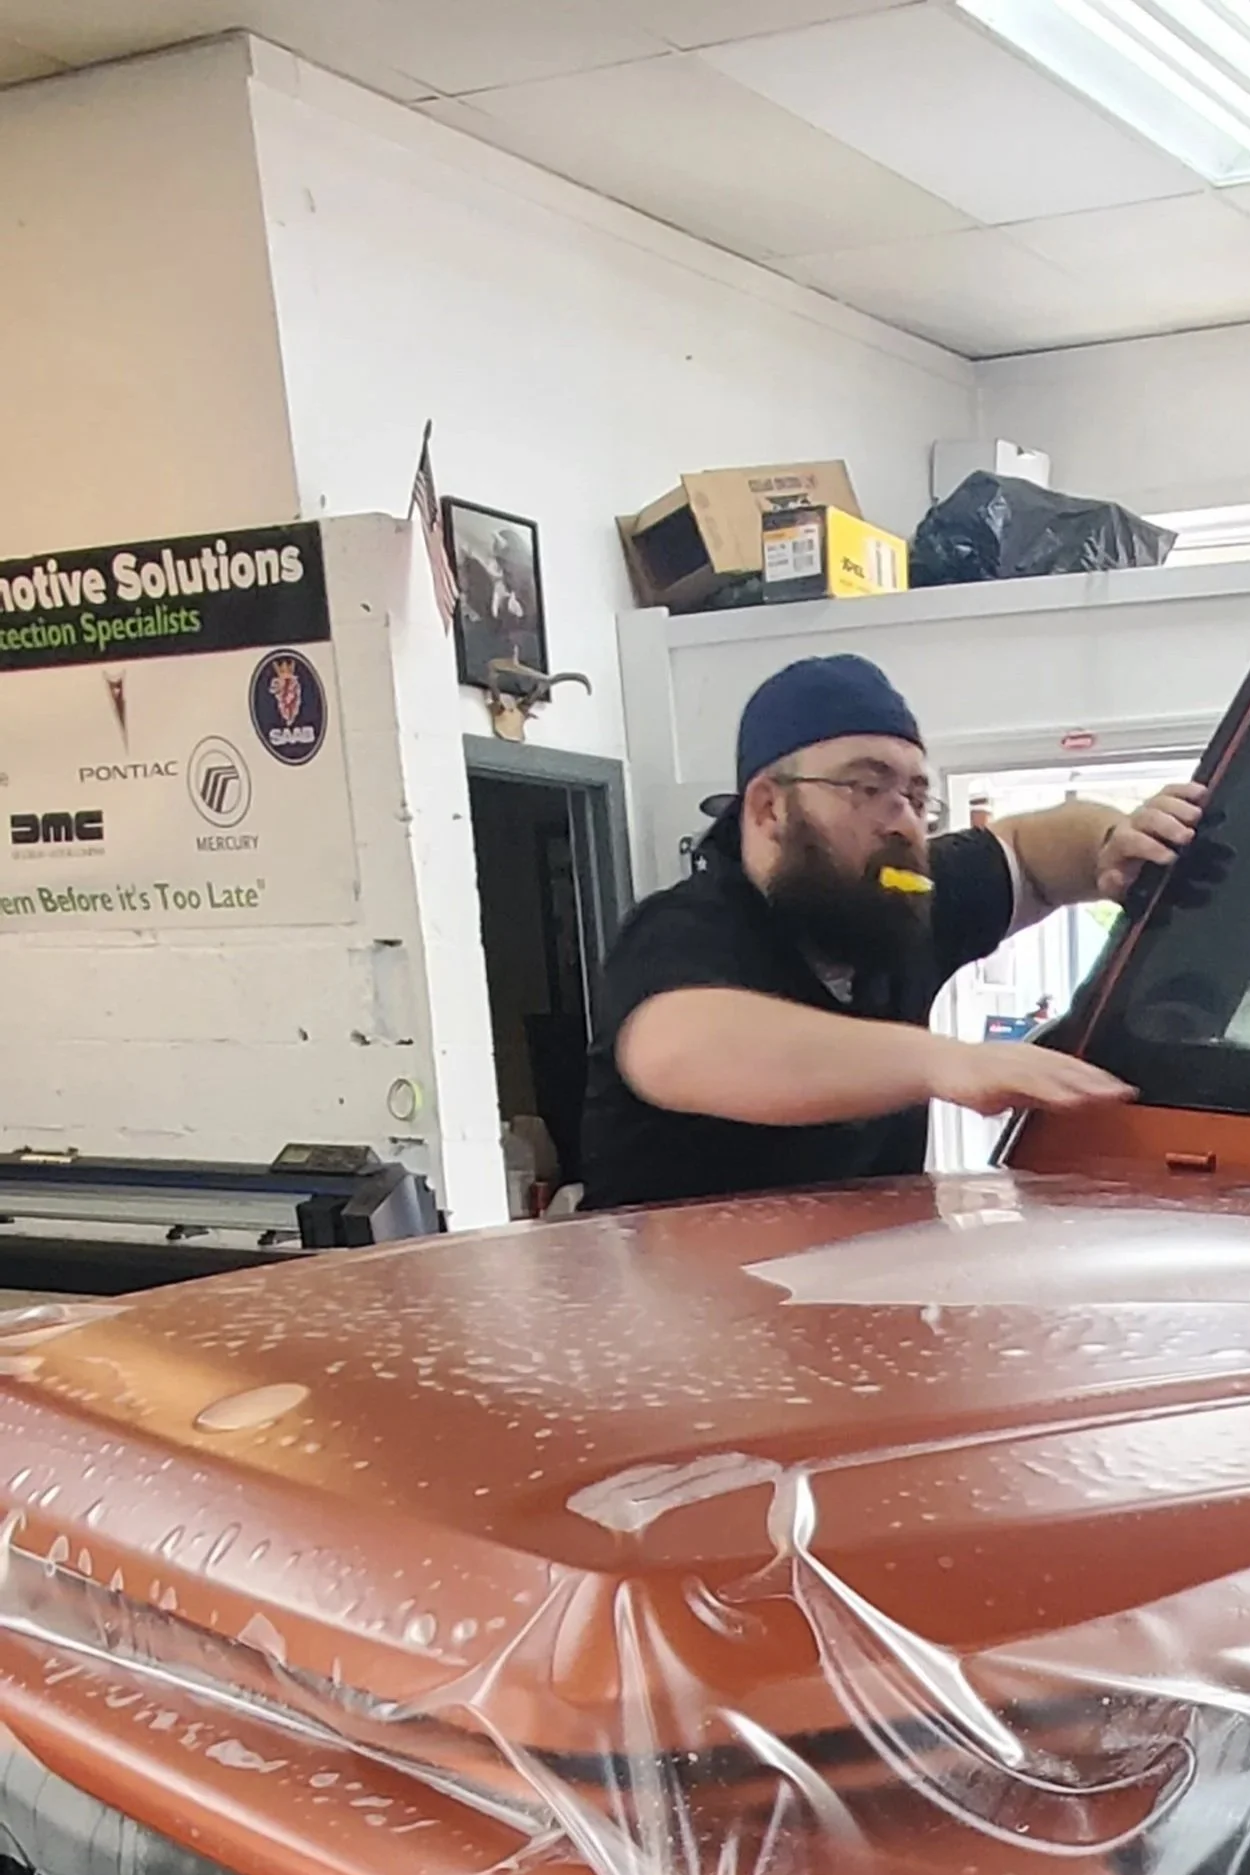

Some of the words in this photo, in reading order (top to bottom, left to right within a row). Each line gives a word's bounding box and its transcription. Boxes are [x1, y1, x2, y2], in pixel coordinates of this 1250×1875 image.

[112, 539, 303, 601] Solutions
[80, 603, 201, 652] Specialists
[269, 726, 315, 745] SAAB
[79, 761, 178, 782] PONTIAC
[196, 835, 259, 851] MERCURY
[37, 886, 114, 912] Before
[116, 883, 151, 911] it's
[153, 883, 201, 910] Too
[206, 878, 265, 908] Late"
